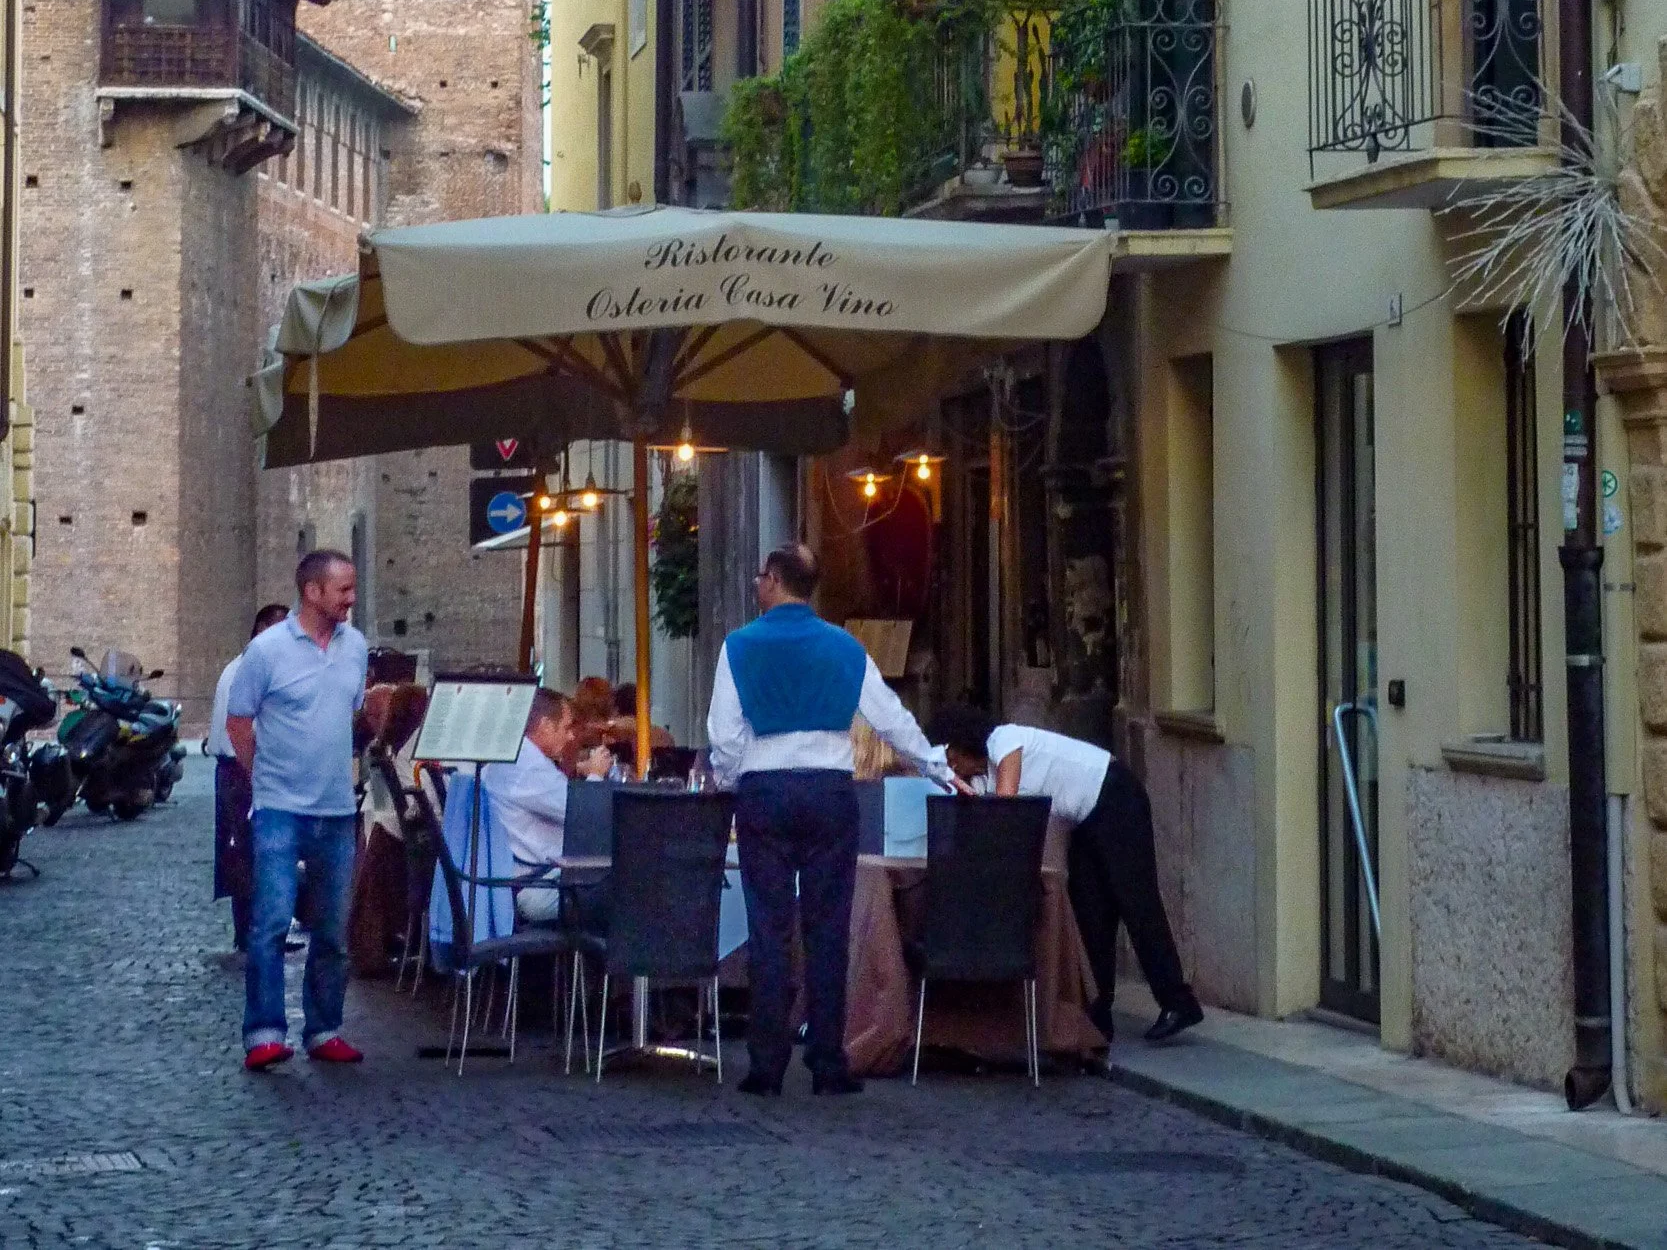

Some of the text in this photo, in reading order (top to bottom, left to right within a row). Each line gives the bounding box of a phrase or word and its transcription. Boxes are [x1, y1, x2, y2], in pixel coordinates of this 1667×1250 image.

[644, 234, 838, 270] Ristorante
[586, 273, 898, 320] Osteria Casa Vino
